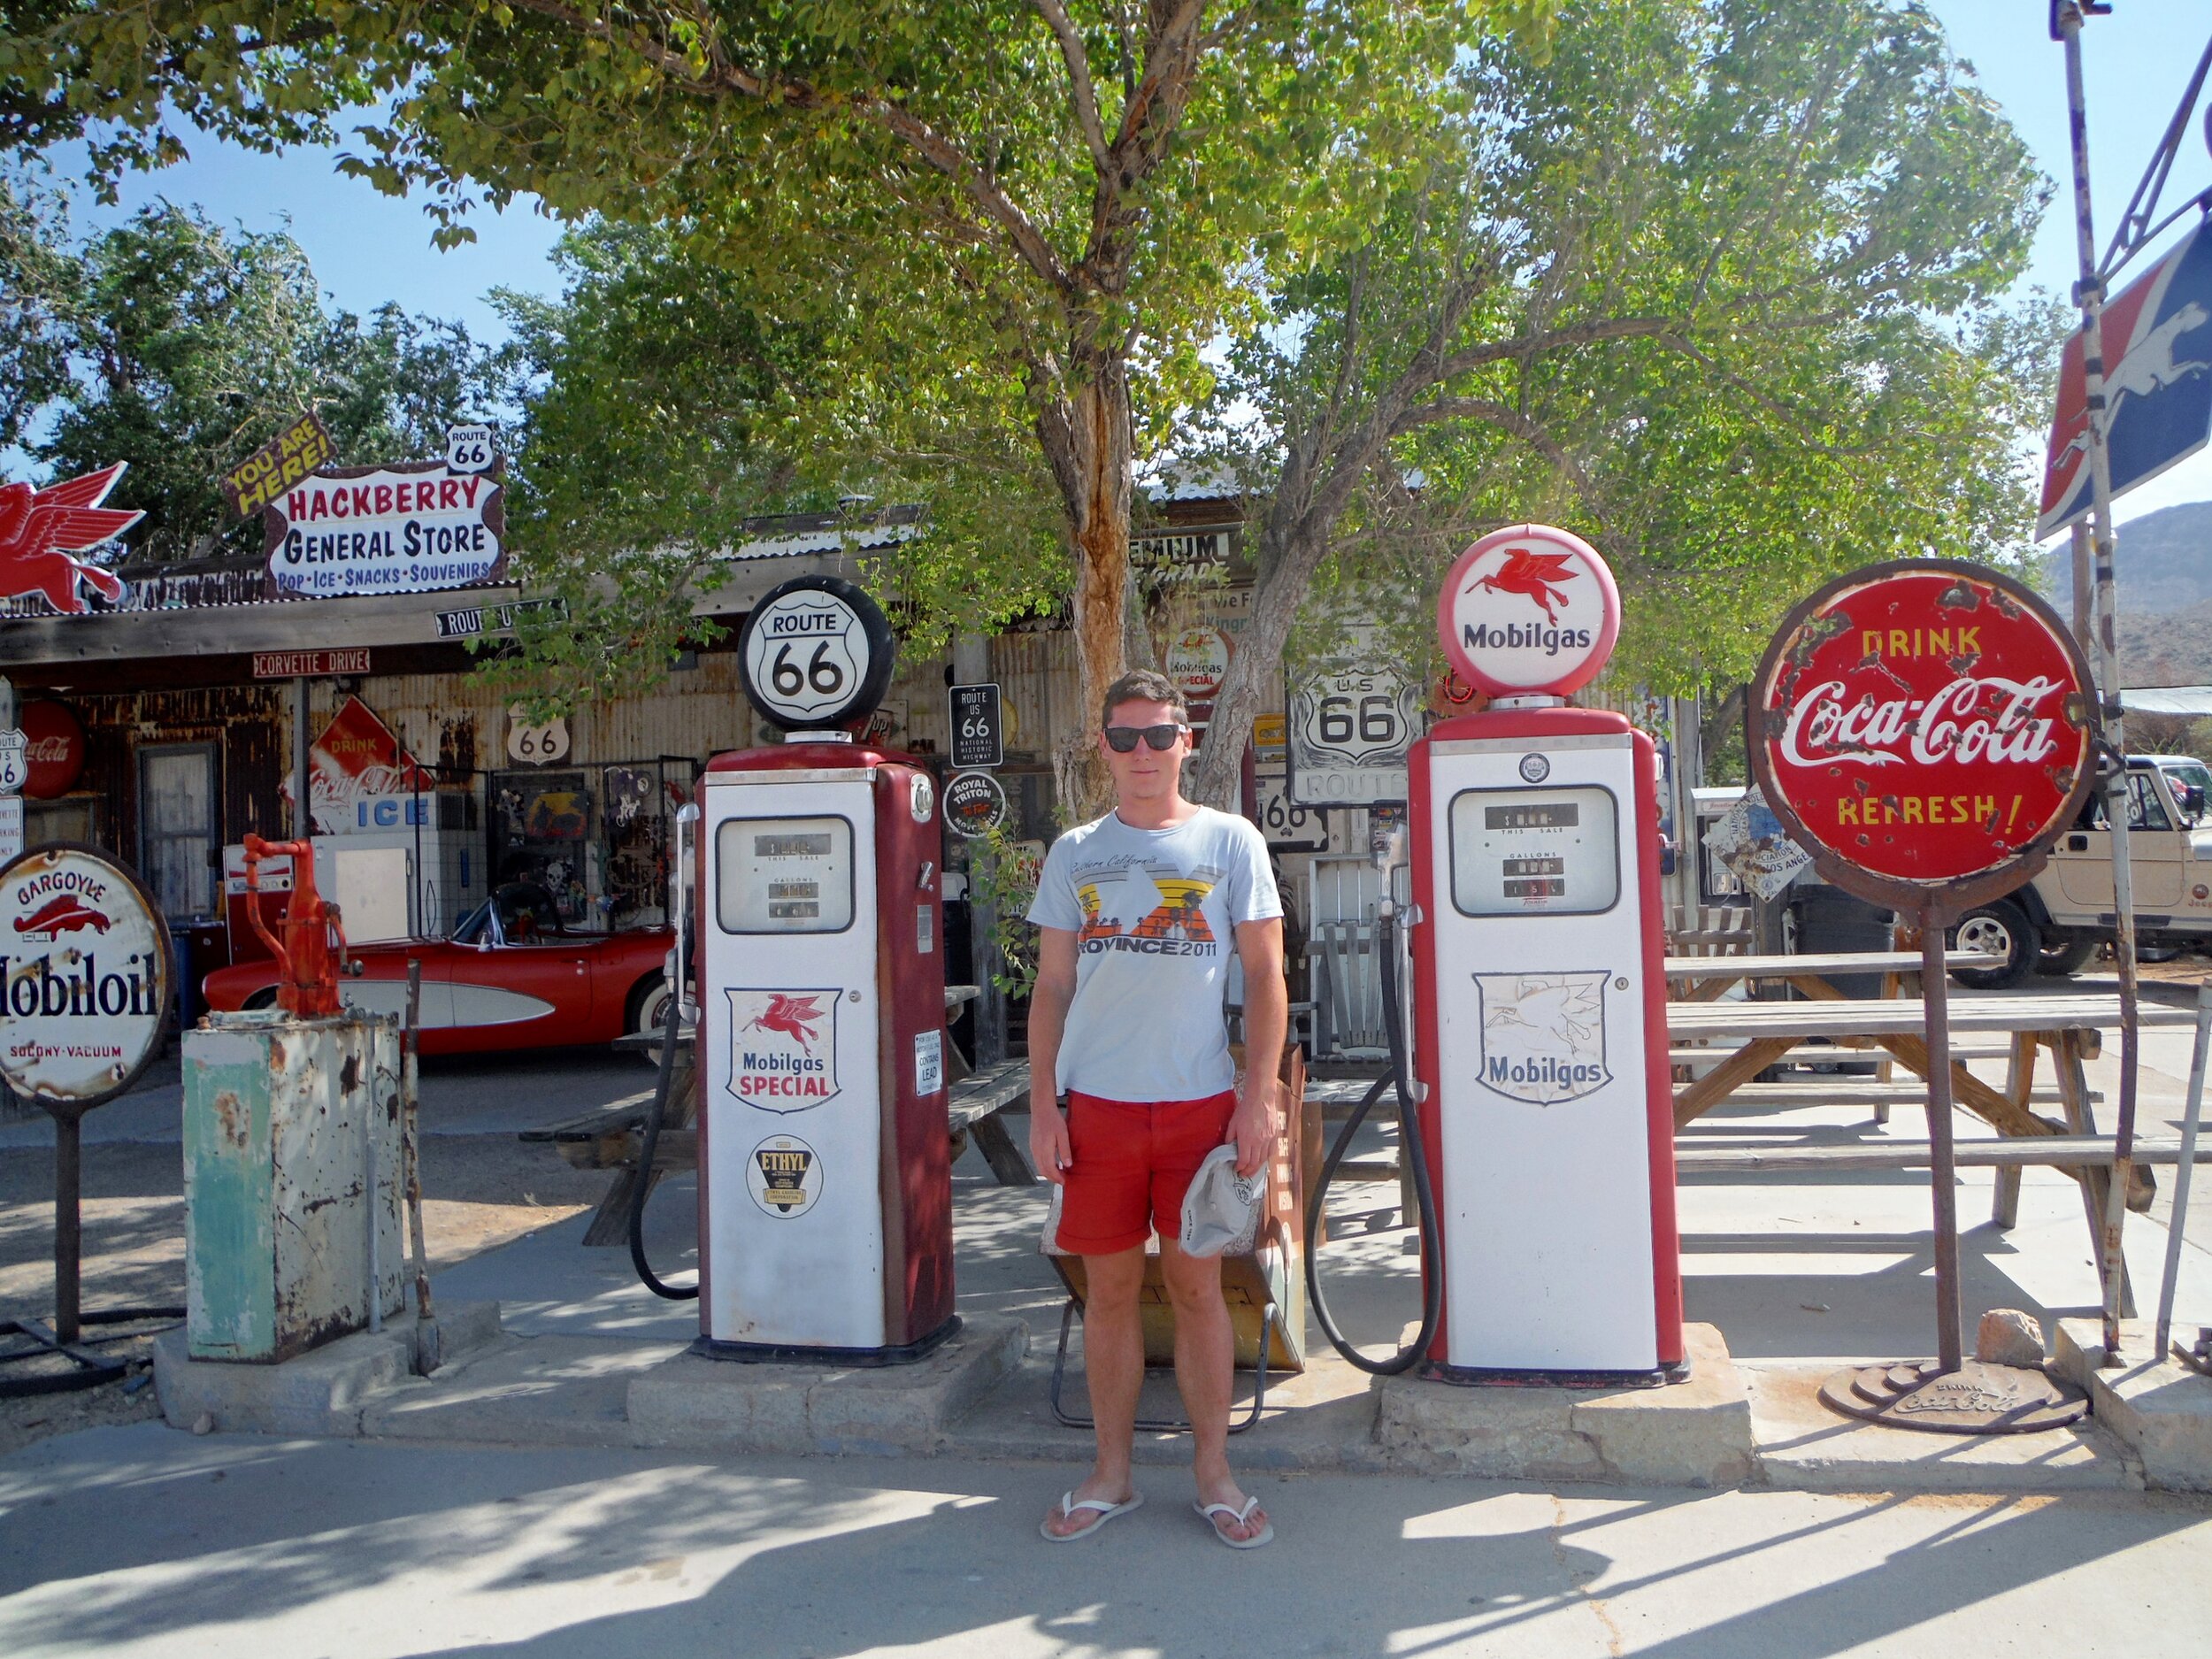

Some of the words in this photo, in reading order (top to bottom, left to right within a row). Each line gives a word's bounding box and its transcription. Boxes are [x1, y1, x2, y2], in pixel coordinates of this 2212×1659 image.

[452, 431, 487, 442] ROUTE
[227, 453, 274, 491] YOU
[280, 417, 319, 457] ARE
[454, 443, 486, 465] 66
[237, 434, 328, 516] HERE!
[287, 475, 480, 522] HACKBERRY
[283, 528, 396, 565] GENERAL
[403, 519, 486, 557] STORE
[1129, 533, 1217, 561] EMIUM
[772, 614, 836, 634] ROUTE
[1464, 622, 1591, 657] Mobilgas
[1862, 626, 1982, 657] DRINK
[259, 654, 320, 674] CORVETTE
[328, 650, 366, 672] DRIVE
[772, 640, 842, 696] 66
[961, 692, 987, 704] ROUTE
[970, 704, 980, 715] US
[962, 717, 990, 738] 66
[1319, 695, 1395, 743] 66
[1779, 675, 2065, 767] Coca-Cola
[331, 738, 377, 752] DRINK
[519, 729, 557, 754] 66
[953, 788, 991, 806] TRITON
[954, 780, 987, 795] ROYAL
[357, 798, 428, 827] ICE
[18, 871, 106, 906] GARGOYLE
[743, 1053, 824, 1075] Mobilgas
[922, 1066, 937, 1081] LEAD
[1489, 1056, 1601, 1090] Mobilgas
[740, 1076, 829, 1096] SPECIAL
[761, 1153, 806, 1171] ETHYL
